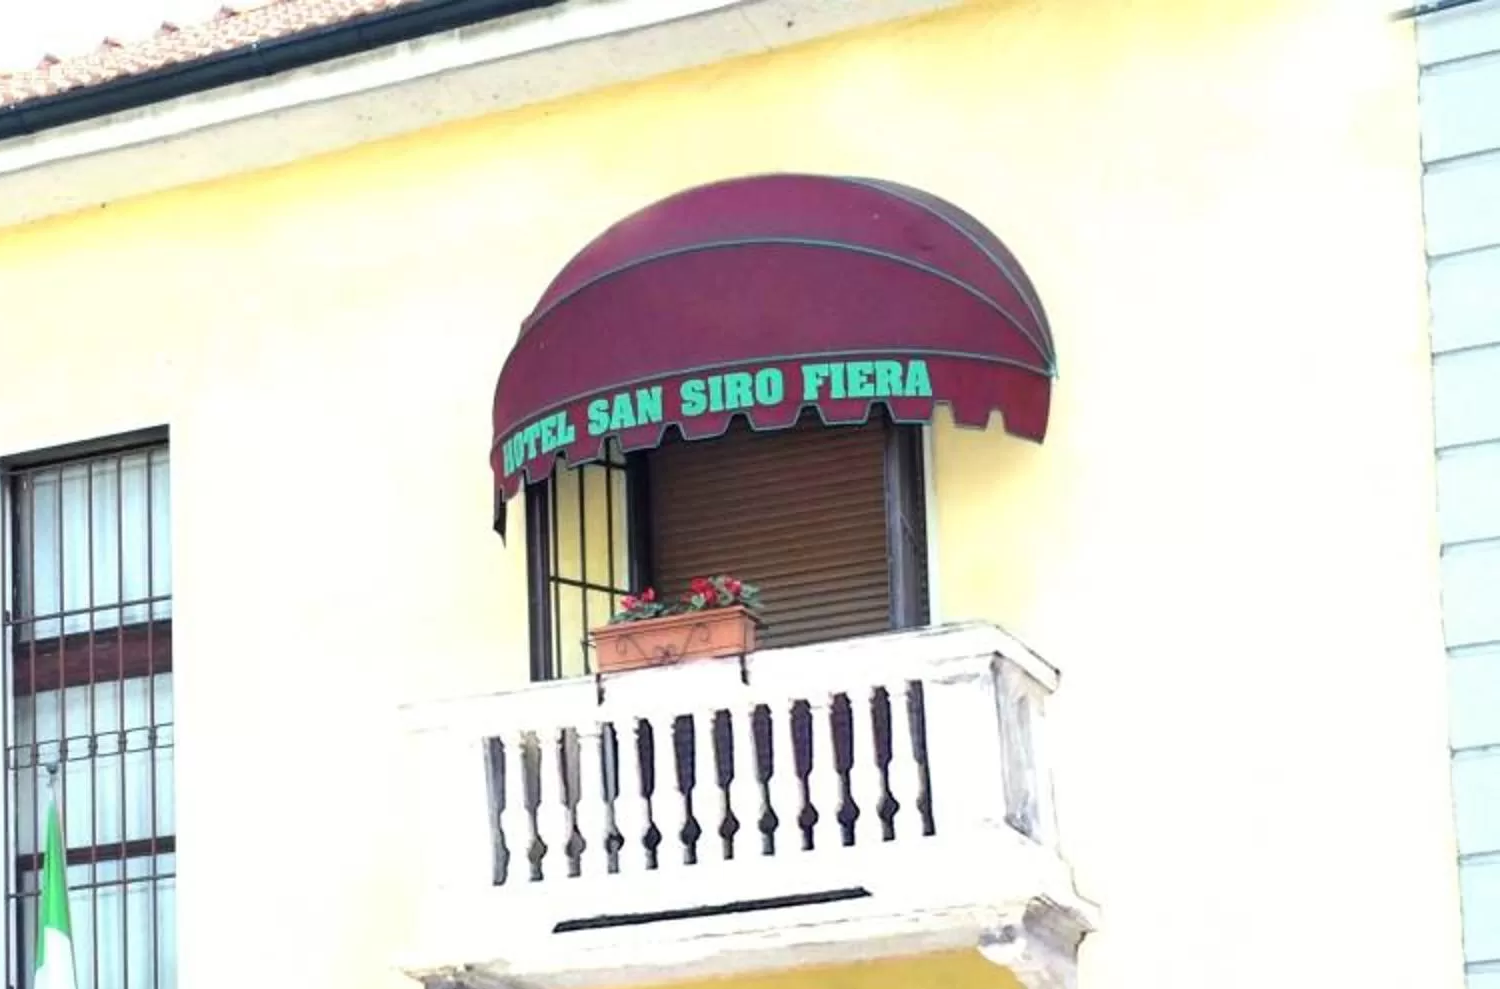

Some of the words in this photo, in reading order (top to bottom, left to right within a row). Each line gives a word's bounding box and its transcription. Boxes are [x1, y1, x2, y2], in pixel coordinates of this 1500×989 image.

[503, 411, 576, 477] HOTEL
[587, 386, 663, 436] SAN
[681, 366, 783, 416] SIRO
[802, 359, 932, 401] FIERA
